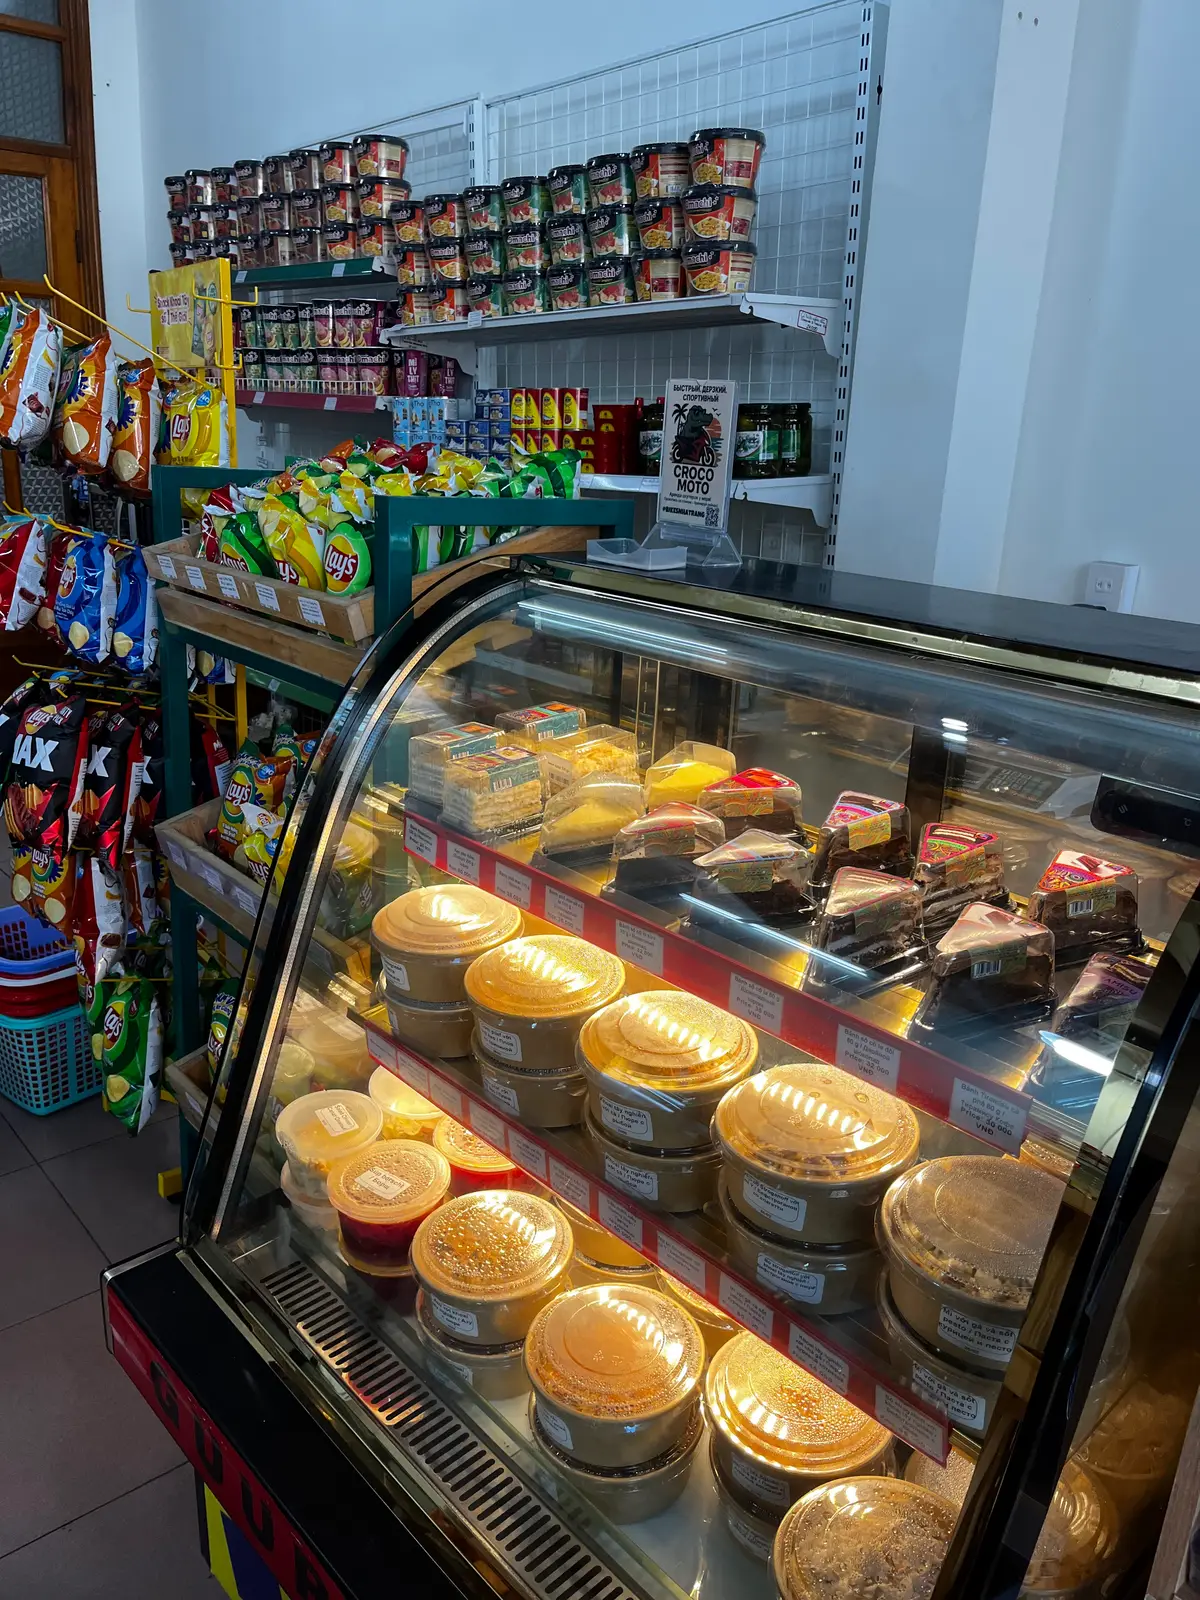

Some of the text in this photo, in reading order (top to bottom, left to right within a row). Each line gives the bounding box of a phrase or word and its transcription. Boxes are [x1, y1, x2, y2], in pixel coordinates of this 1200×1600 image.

[409, 367, 418, 375] LY
[682, 393, 719, 402] СПОРТИВНЫЙ
[673, 464, 714, 482] CROCO
[677, 478, 709, 495] MOTO
[325, 545, 358, 581] Lay's
[225, 780, 252, 806] Lay's
[844, 1028, 860, 1040] Bánh
[844, 1050, 890, 1076] Price: 32 000
[961, 1083, 979, 1096] Bánh
[960, 1106, 1013, 1137] Price: 30 000
[943, 1316, 967, 1332] pesto
[974, 1330, 1001, 1343] Паста
[955, 1314, 969, 1325] với
[972, 1321, 982, 1330] gà
[986, 1343, 1013, 1354] песто
[937, 1383, 947, 1391] gà
[951, 1405, 977, 1419] песто
